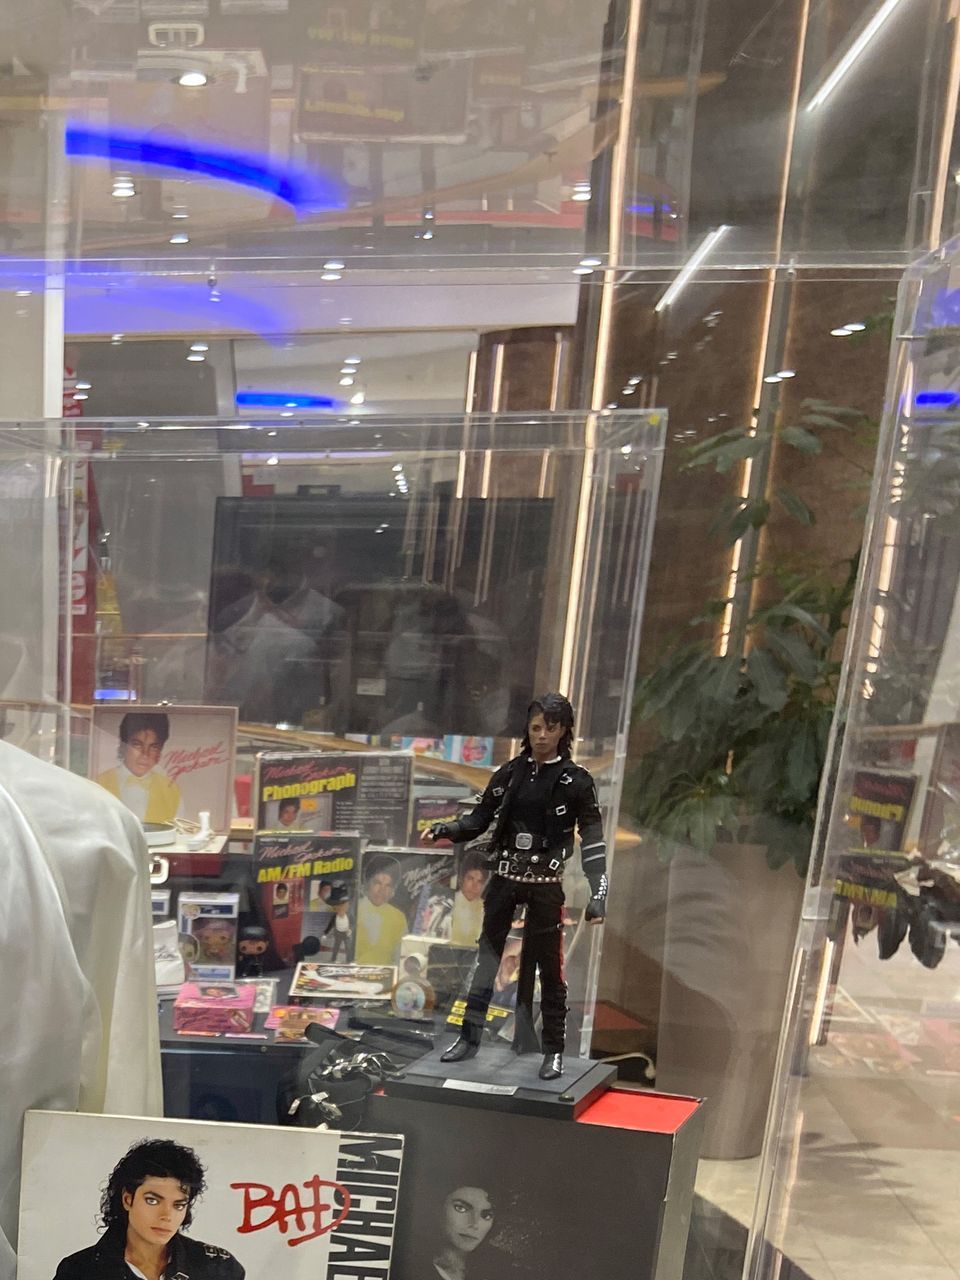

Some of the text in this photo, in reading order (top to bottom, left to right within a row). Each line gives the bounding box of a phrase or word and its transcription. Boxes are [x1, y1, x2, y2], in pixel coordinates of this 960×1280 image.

[263, 772, 356, 802] Phonograph
[257, 857, 354, 883] AM/FM Radio
[230, 1175, 351, 1247] BAD
